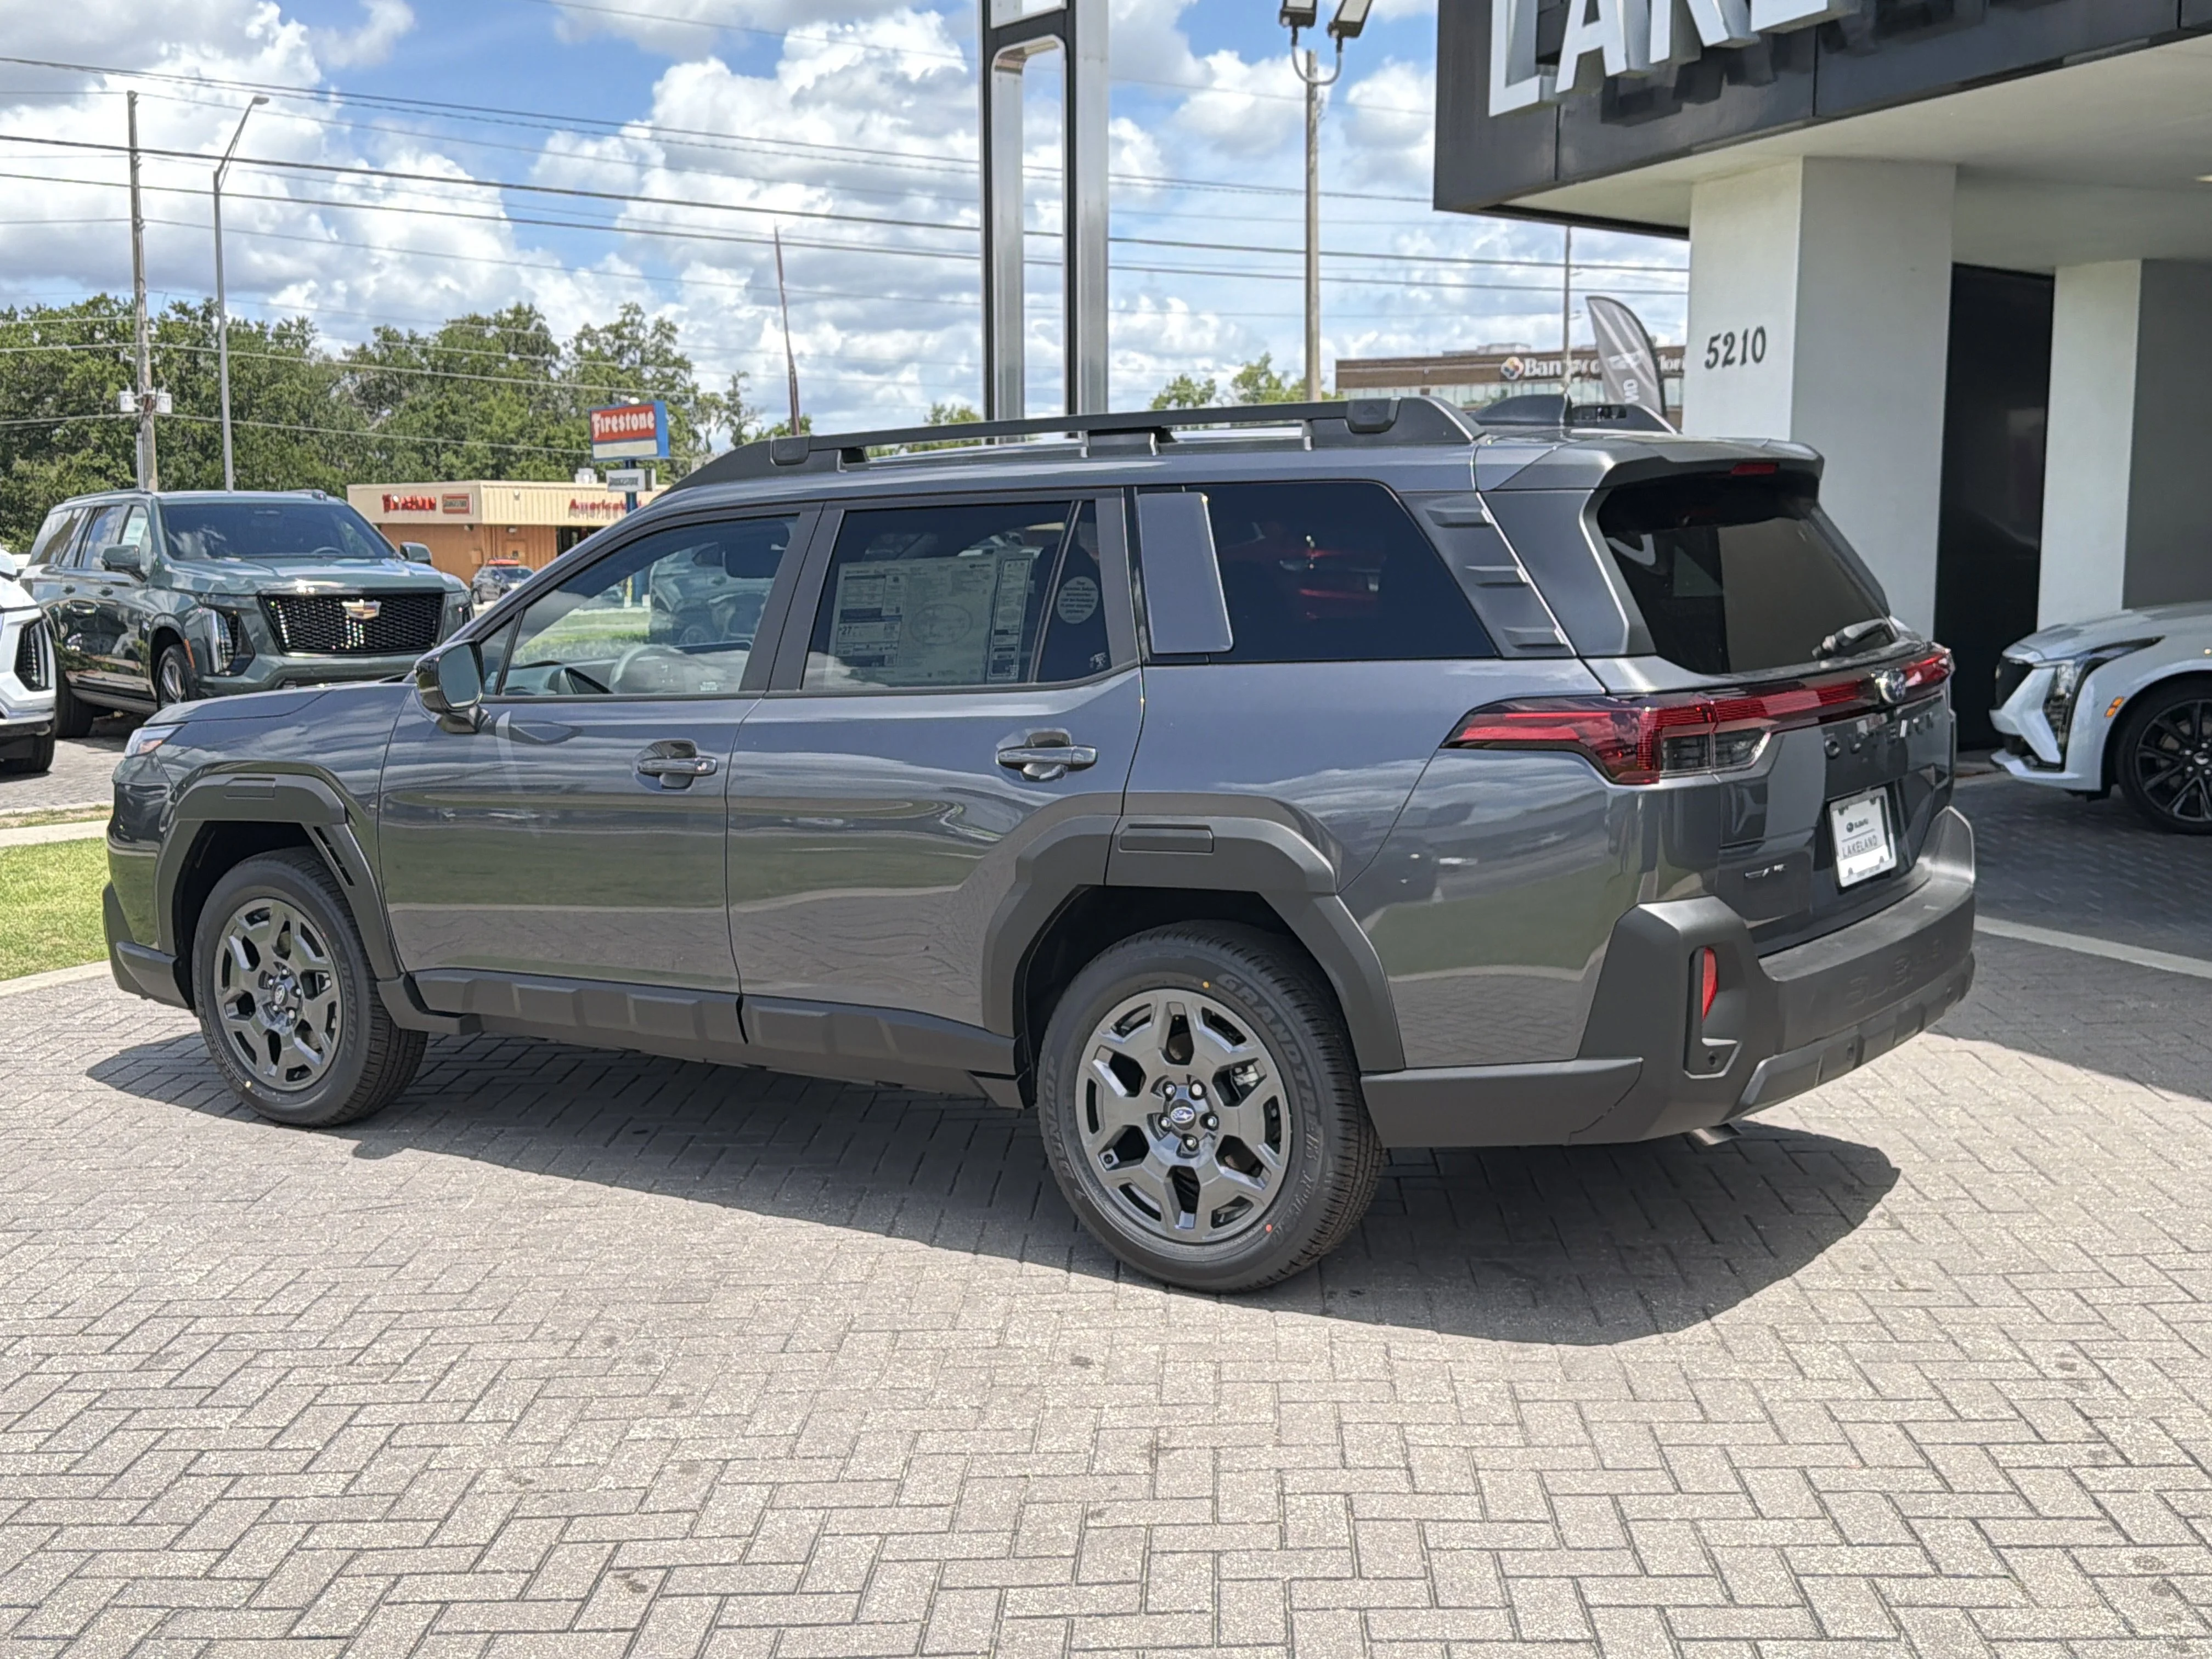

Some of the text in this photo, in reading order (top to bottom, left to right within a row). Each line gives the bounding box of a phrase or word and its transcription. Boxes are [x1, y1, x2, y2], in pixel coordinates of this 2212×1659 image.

[1488, 0, 1828, 117] LA
[1705, 326, 1766, 369] 5210
[1525, 357, 1564, 377] Ban
[591, 411, 654, 438] Firestone
[1842, 834, 1878, 858] LAKELAND
[1046, 1055, 1076, 1180] DUNLOP
